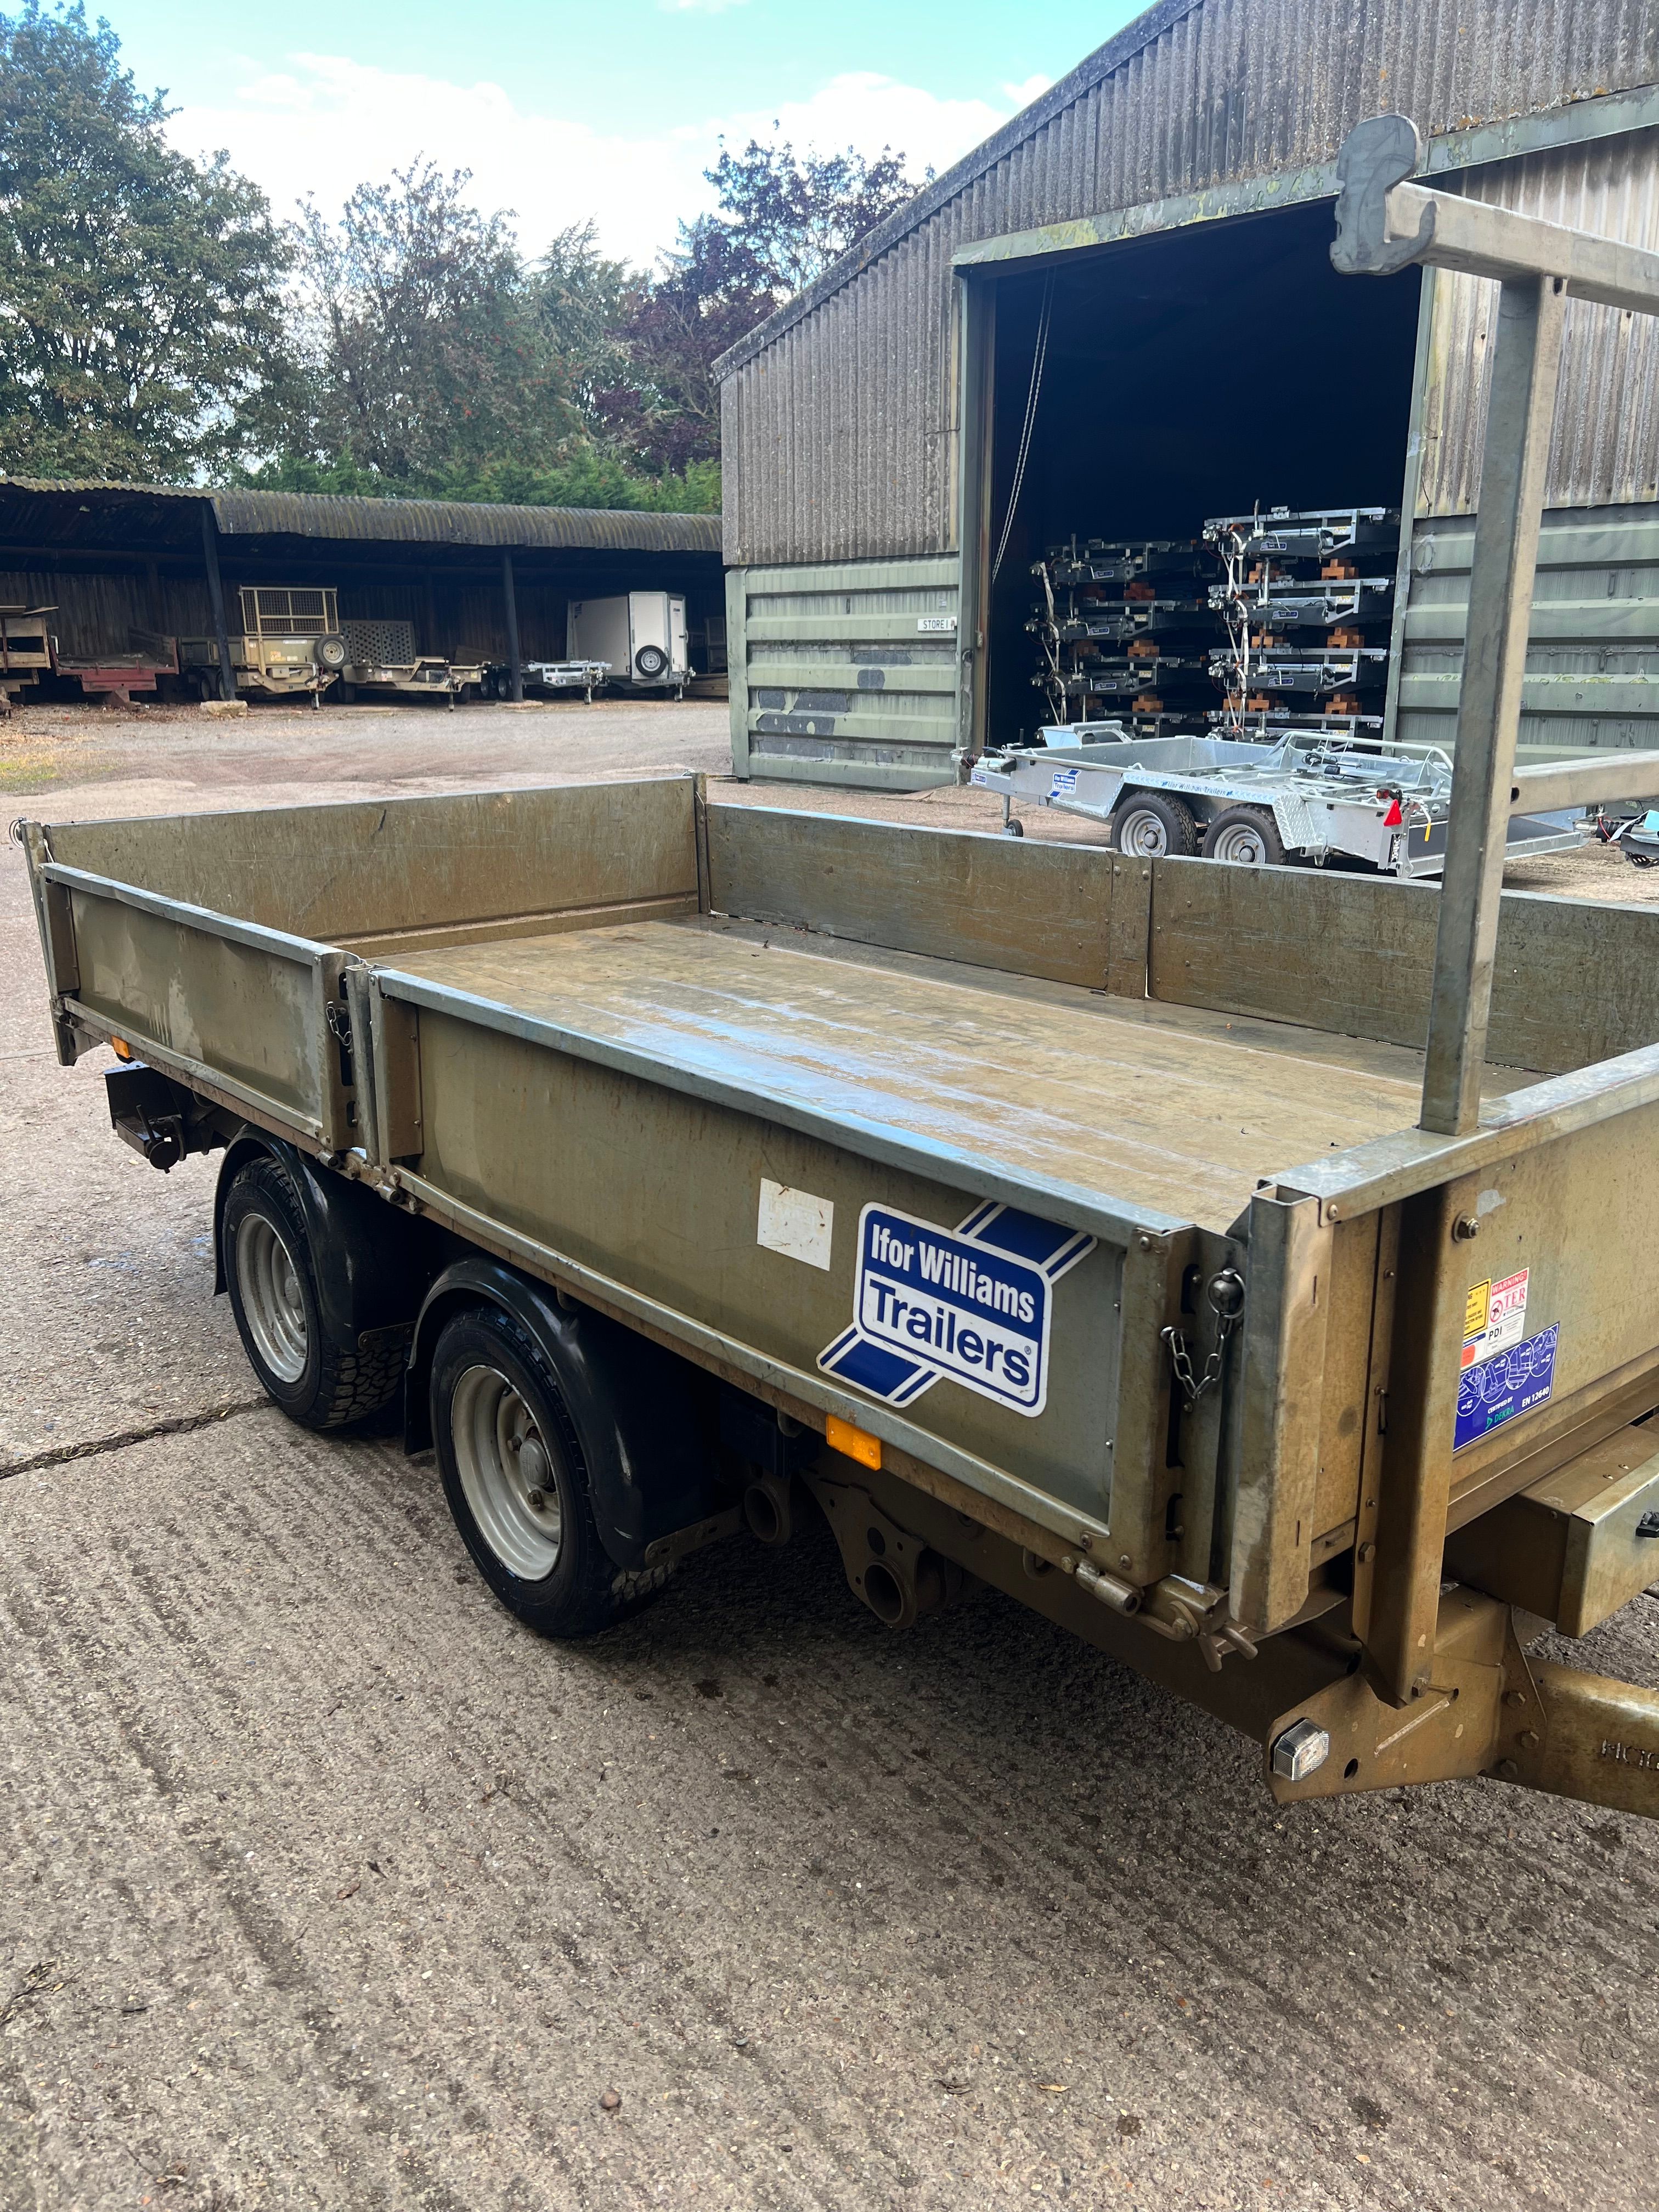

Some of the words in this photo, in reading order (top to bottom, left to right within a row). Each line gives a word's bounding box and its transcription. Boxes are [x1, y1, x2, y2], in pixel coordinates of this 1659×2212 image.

[923, 620, 944, 629] STORE
[871, 1224, 914, 1272] Ifor
[919, 1241, 1035, 1323] Williams
[1492, 1271, 1527, 1294] WARNING!
[1504, 1288, 1525, 1308] TER
[1489, 1326, 1502, 1340] PDI
[1521, 1396, 1531, 1408] EN
[1532, 1386, 1550, 1402] 12640
[1487, 1400, 1507, 1414] CERTIFIED
[1494, 1406, 1515, 1423] DEKRA
